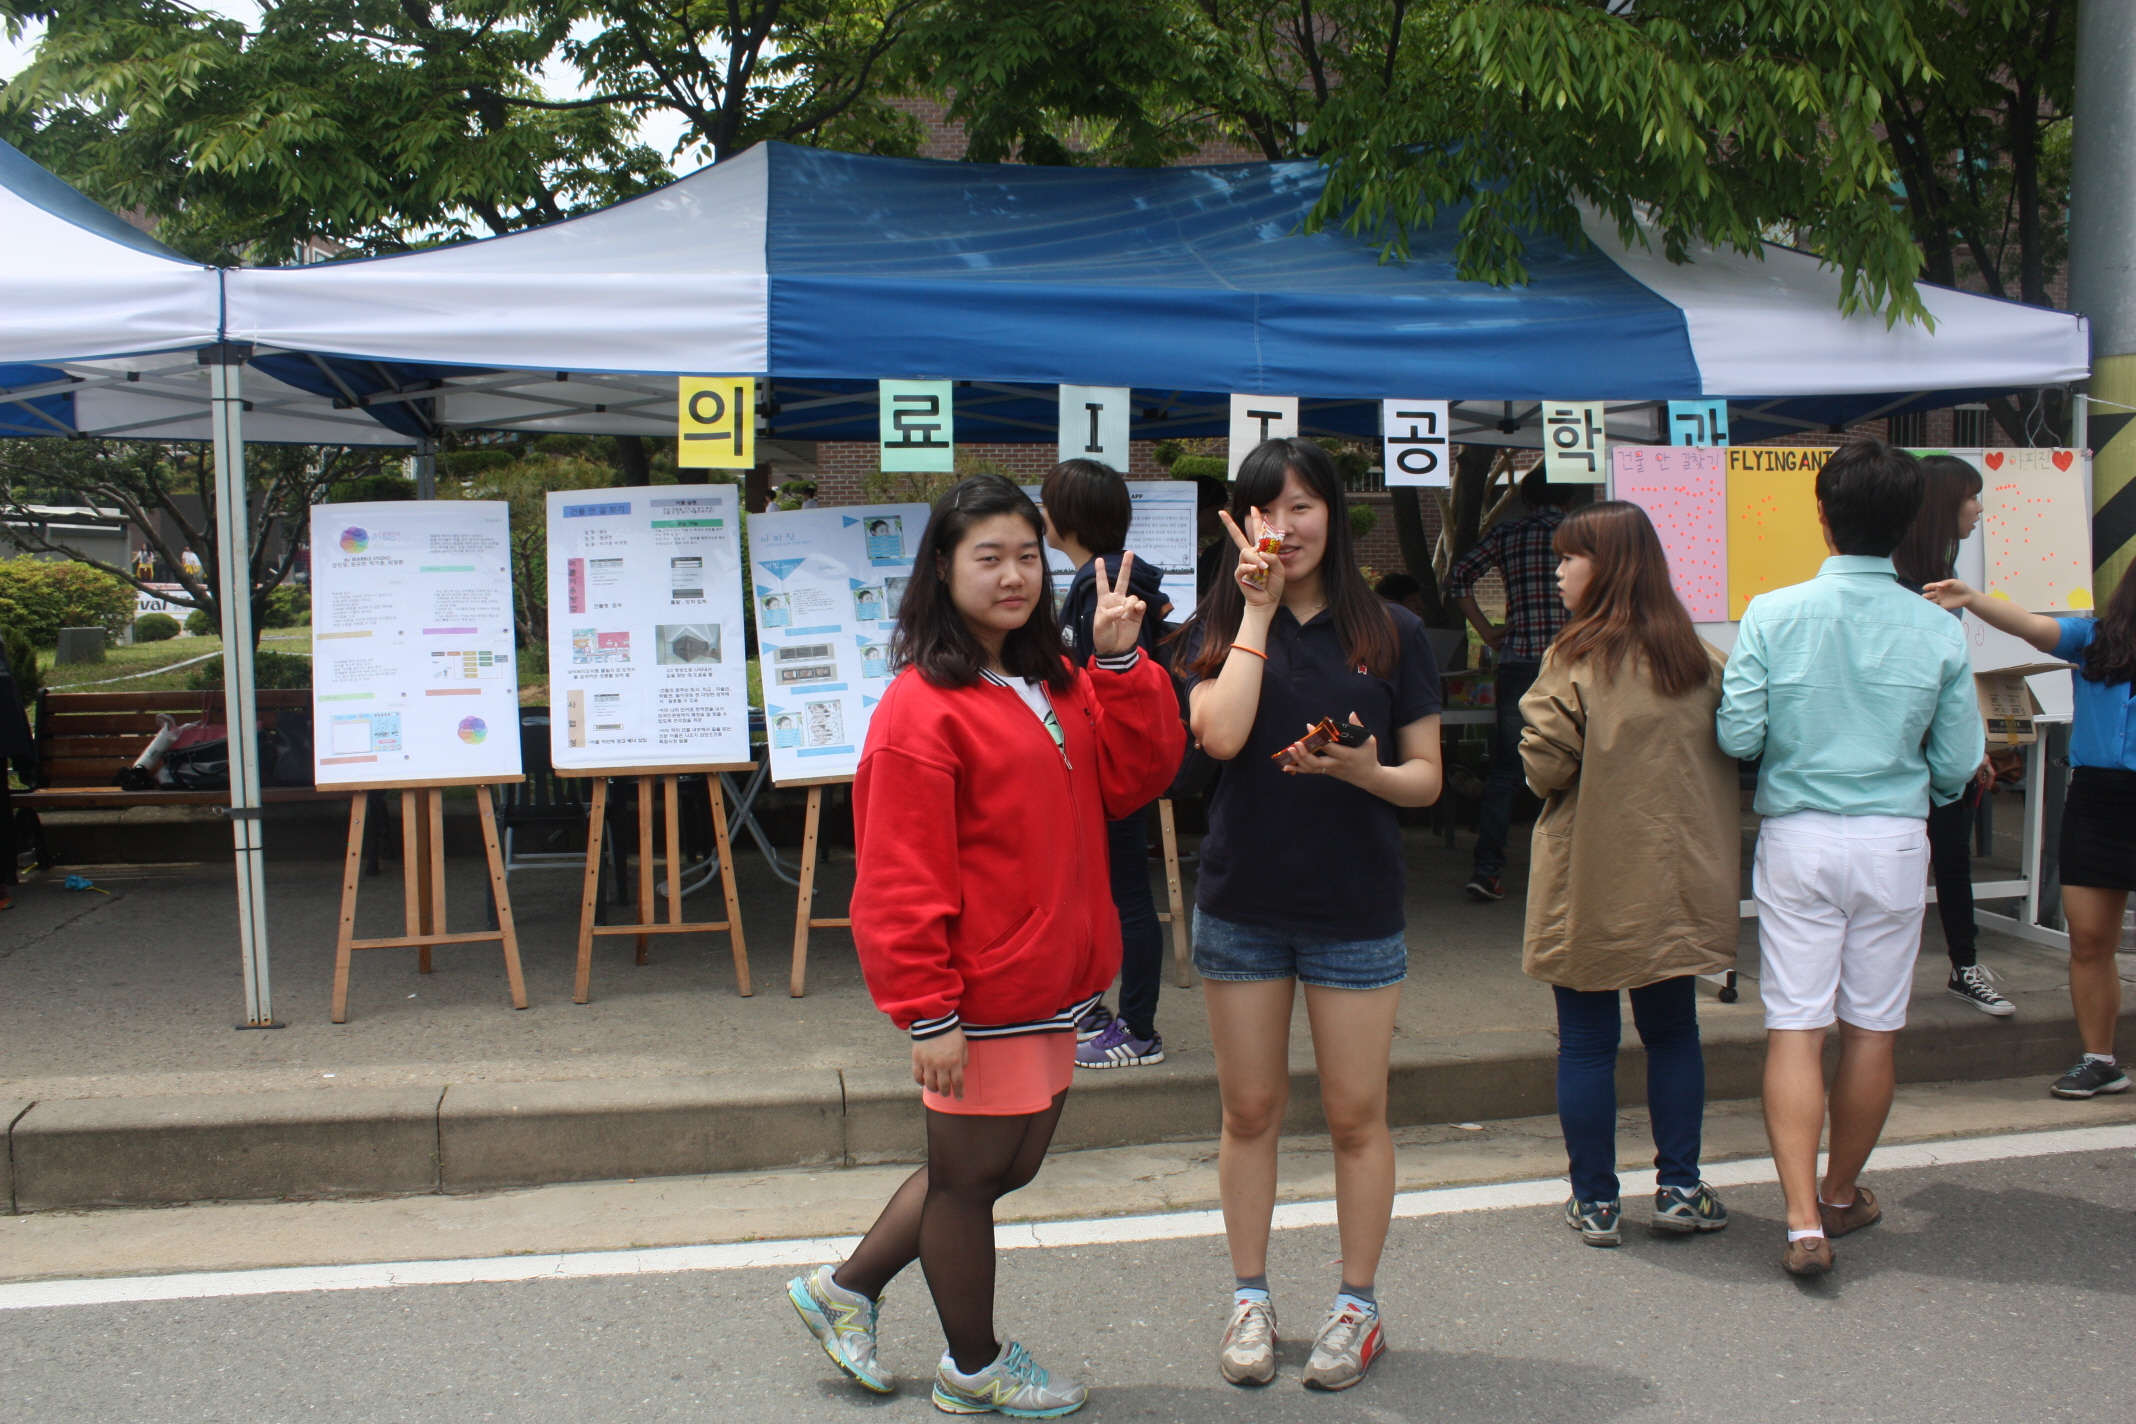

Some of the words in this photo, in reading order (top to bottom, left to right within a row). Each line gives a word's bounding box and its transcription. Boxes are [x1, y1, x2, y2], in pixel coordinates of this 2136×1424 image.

[683, 386, 744, 458] 의
[883, 393, 950, 450] 료
[1084, 402, 1104, 453] I
[1387, 410, 1446, 475] 공
[1546, 408, 1603, 472] 학
[1618, 450, 1644, 472] 건물
[1656, 452, 1670, 471] 안
[2009, 449, 2051, 470] 아피진
[570, 507, 585, 516] 건물
[588, 507, 595, 515] 안
[136, 599, 168, 611] val
